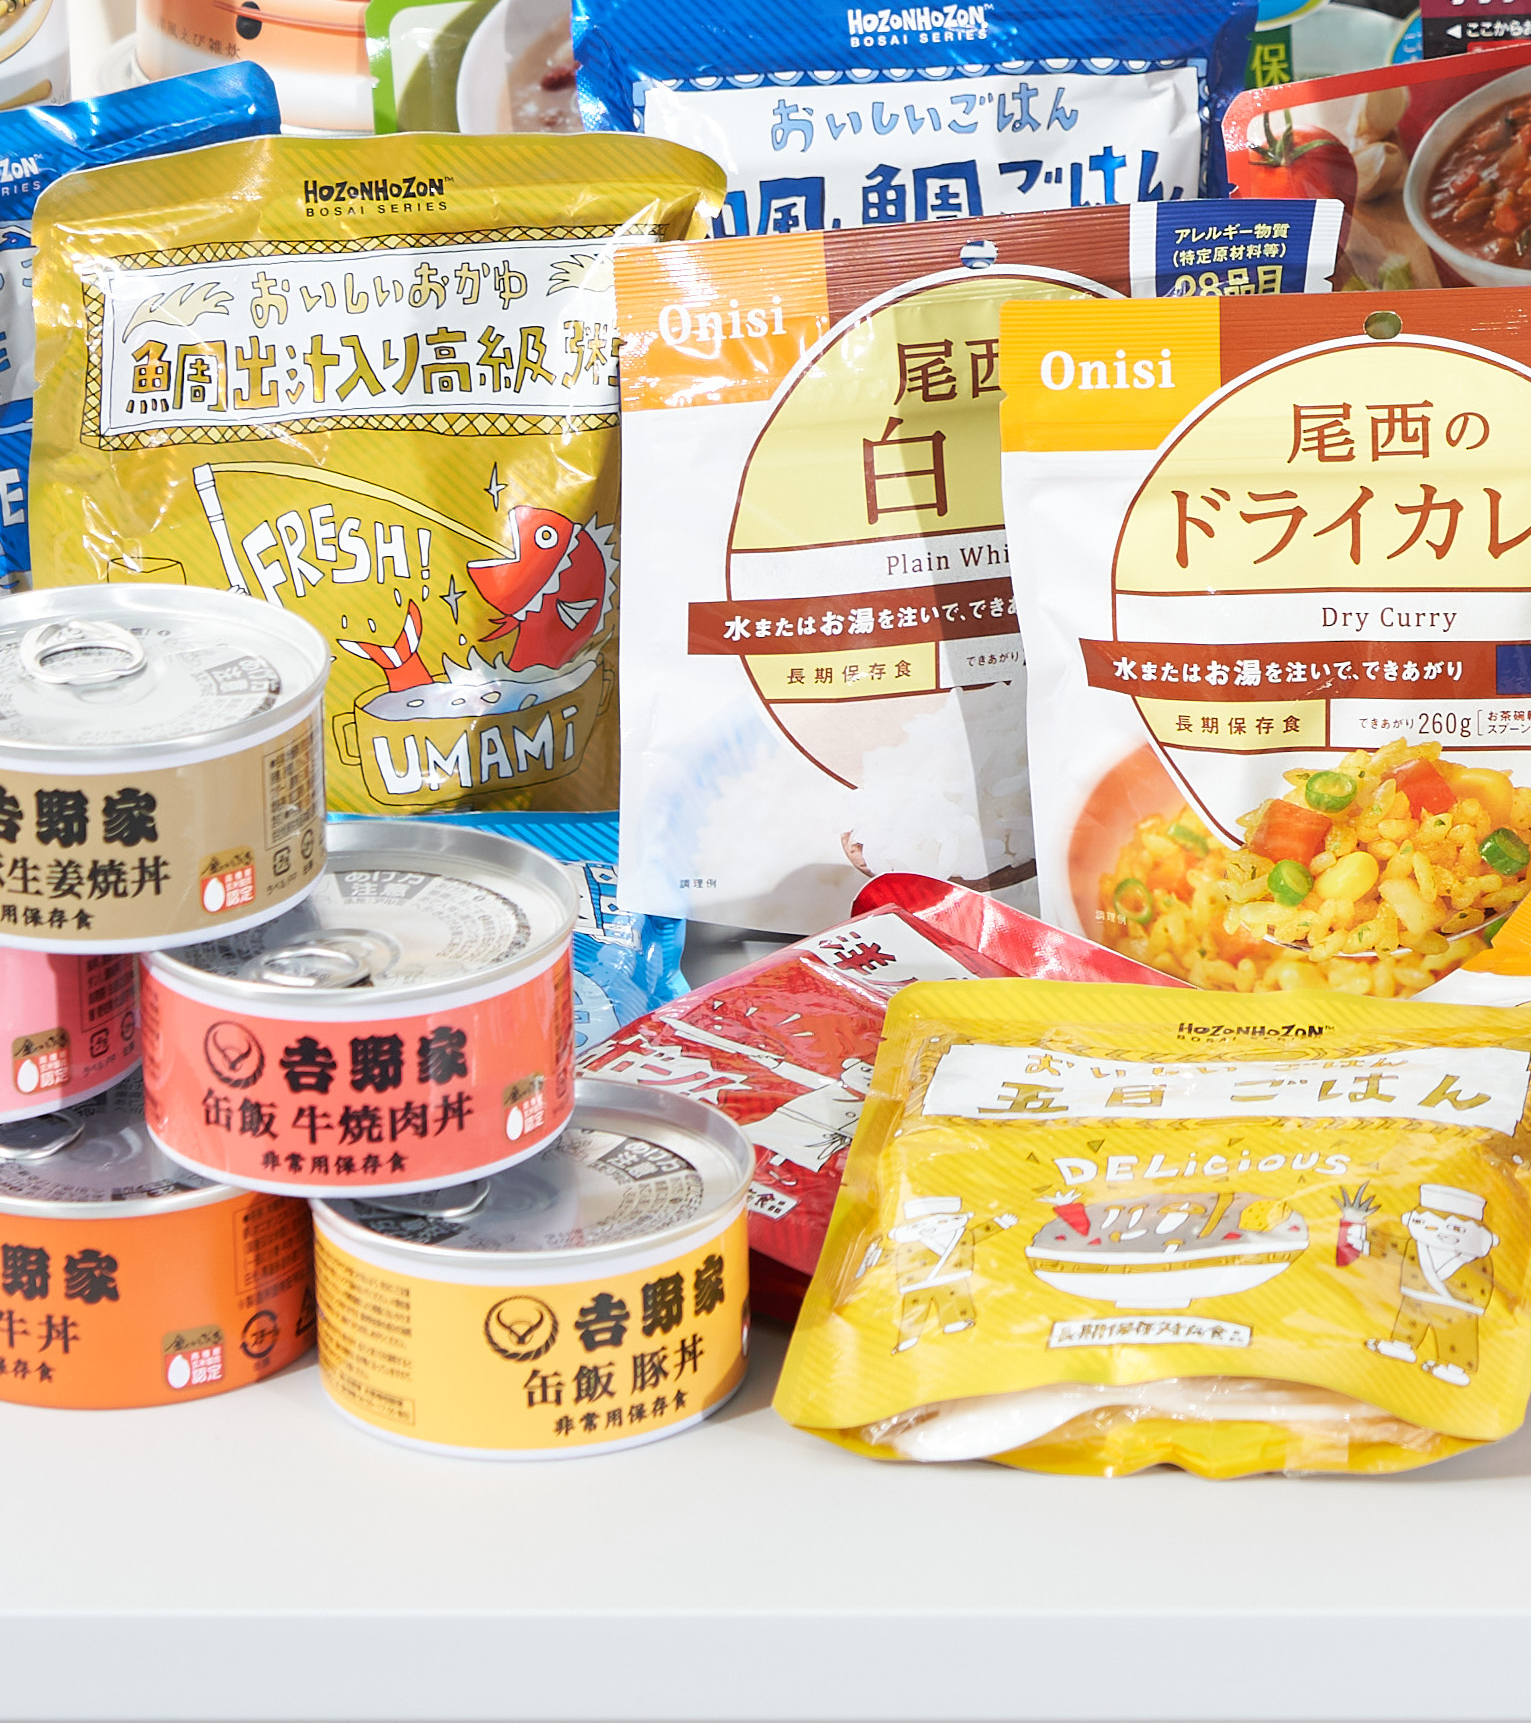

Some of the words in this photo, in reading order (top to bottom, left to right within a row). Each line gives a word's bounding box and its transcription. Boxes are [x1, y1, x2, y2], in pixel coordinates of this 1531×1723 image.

[850, 33, 909, 48] BOSAI
[919, 29, 988, 46] SERIES
[770, 82, 1081, 153] おいしいごはん
[305, 204, 362, 218] BOSAI
[377, 200, 448, 215] SERIES
[1174, 222, 1290, 245] アレルギー物質
[1172, 242, 1288, 266] (特定原材料等)
[249, 259, 530, 329] おいしいおかゆ
[658, 295, 786, 347] Onisi
[1039, 349, 1176, 391] Onisi
[1286, 400, 1492, 465] 尾西の
[886, 549, 951, 576] Plain
[959, 545, 1011, 571] Whi
[1321, 606, 1370, 634] Dry
[1379, 605, 1459, 632] Curry
[786, 657, 914, 686] 長期保存食
[1112, 655, 1465, 688] 水またはお湯を注いで、できあがり
[1174, 713, 1303, 735] 長期保存食
[1358, 714, 1415, 730] できあがり
[1417, 709, 1473, 741] 260g
[373, 707, 577, 796] UMAMI
[679, 878, 717, 891] 調理例
[279, 1025, 469, 1095] 吉野家
[201, 1087, 279, 1140] 缶飯
[291, 1090, 474, 1146] 牛焼肉丼
[261, 1150, 408, 1176] 非常用保存食
[573, 1253, 726, 1353] 吉野家
[523, 1360, 615, 1410] 缶飯
[631, 1333, 705, 1395] 豚丼
[553, 1388, 689, 1437] 非常用保存食
